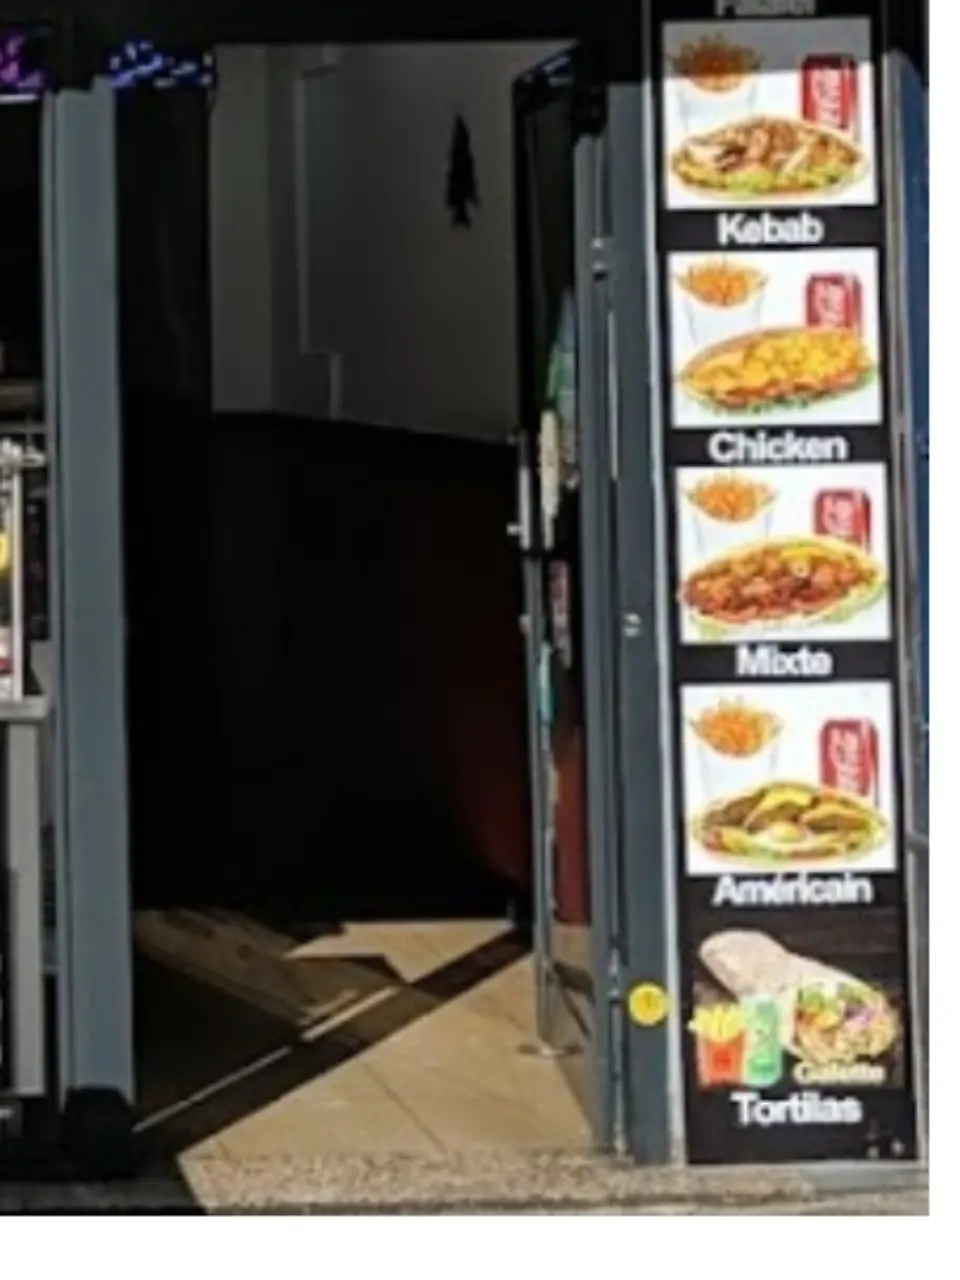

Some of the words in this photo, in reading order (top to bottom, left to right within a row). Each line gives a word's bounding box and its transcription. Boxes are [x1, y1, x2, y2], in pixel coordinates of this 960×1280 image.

[717, 213, 824, 245] Kebab
[708, 431, 849, 463] Chicken
[735, 645, 833, 676] Mixte
